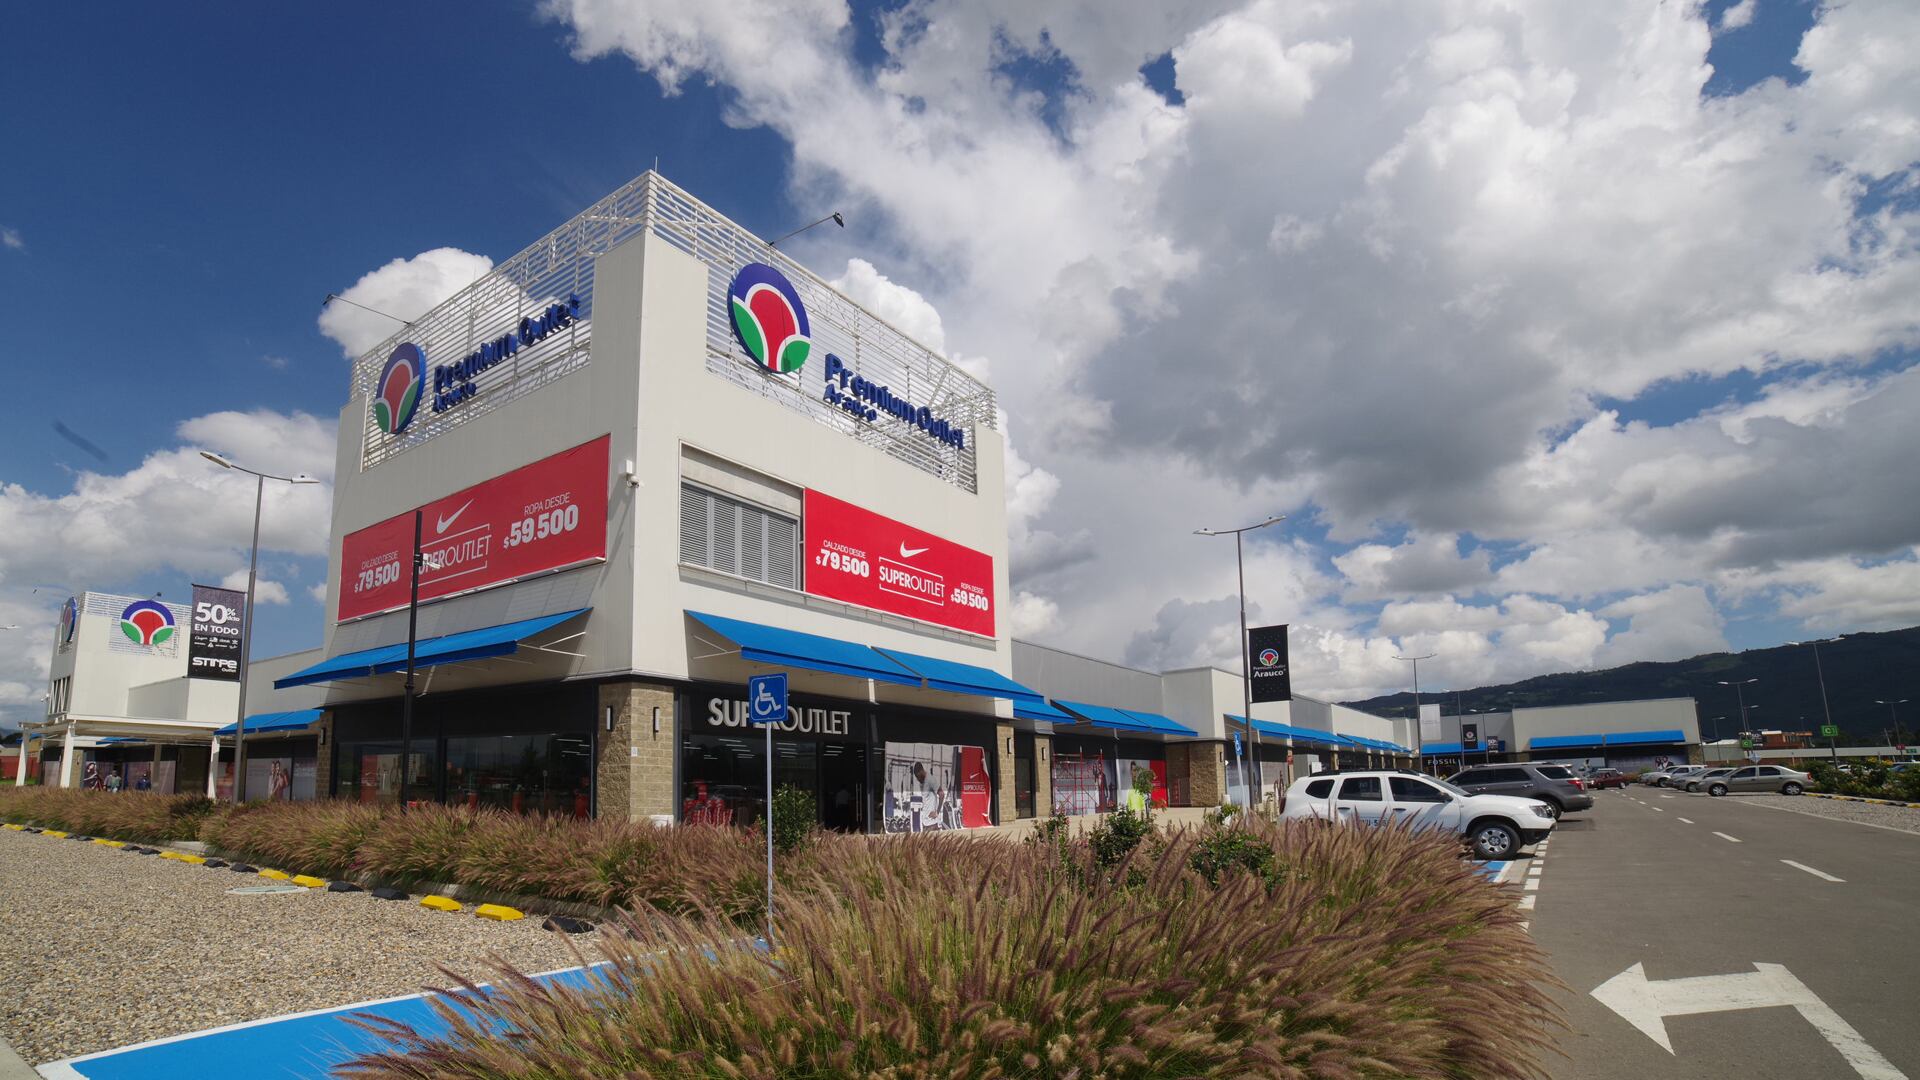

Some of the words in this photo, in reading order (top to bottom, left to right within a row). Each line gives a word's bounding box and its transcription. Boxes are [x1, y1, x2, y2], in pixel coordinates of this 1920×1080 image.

[823, 384, 878, 421] Arauco
[824, 352, 917, 424] Premium
[917, 406, 965, 450] Outlet
[524, 502, 544, 517] ROPA
[544, 492, 571, 509] DESDE
[503, 504, 579, 549] $59.500
[418, 534, 492, 576] UPEROUTLET
[815, 548, 870, 578] $79.500
[823, 539, 849, 554] CALZADO
[849, 547, 867, 559] DESDE
[354, 560, 400, 593] $79.500
[879, 565, 945, 598] SUPEROUTLET
[950, 588, 989, 611] $59.500
[194, 623, 208, 632] EN
[210, 625, 239, 635] TODO
[1254, 670, 1284, 678] Arauco
[707, 697, 851, 735] SUPOUTLET
